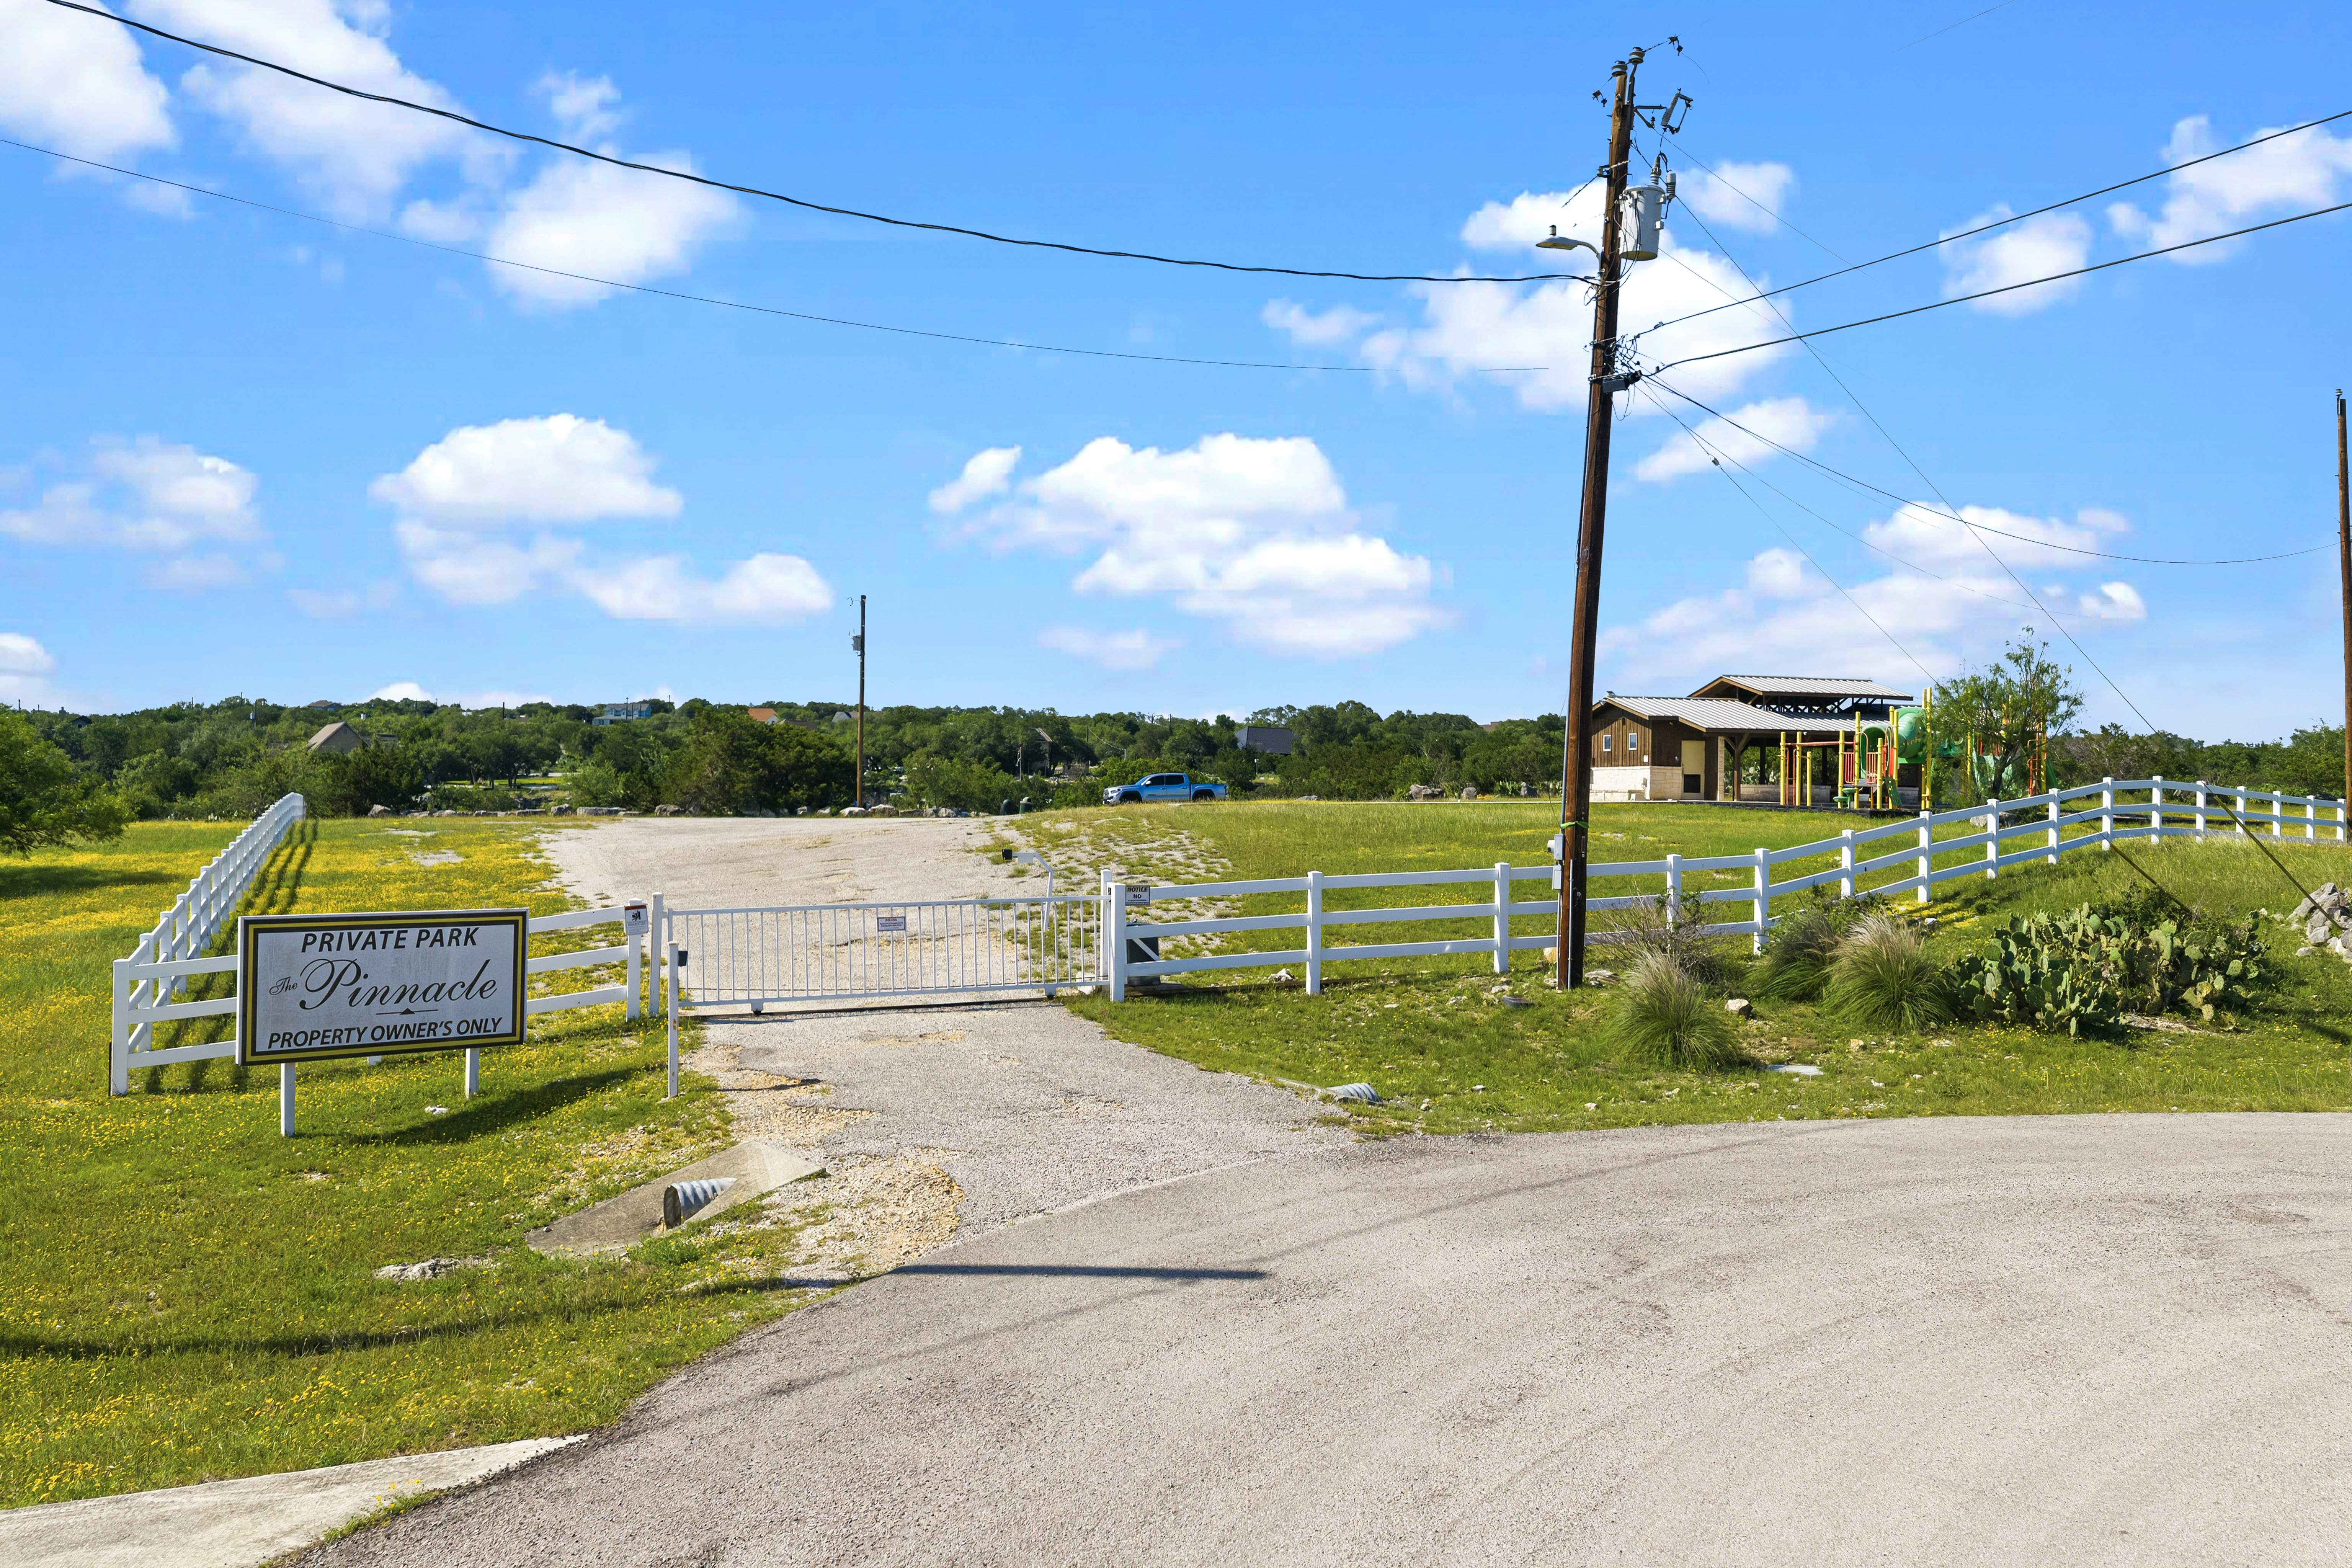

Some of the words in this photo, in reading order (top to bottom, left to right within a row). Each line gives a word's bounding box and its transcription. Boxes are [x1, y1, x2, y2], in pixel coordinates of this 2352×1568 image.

[301, 929, 408, 953] PRIVATE
[416, 927, 480, 949] PARK
[269, 976, 298, 996] The
[299, 958, 498, 1010] Pinnacle
[268, 1026, 368, 1049] PROPERTY
[371, 1019, 453, 1041] OWNER'S
[456, 1017, 503, 1036] ONLY
